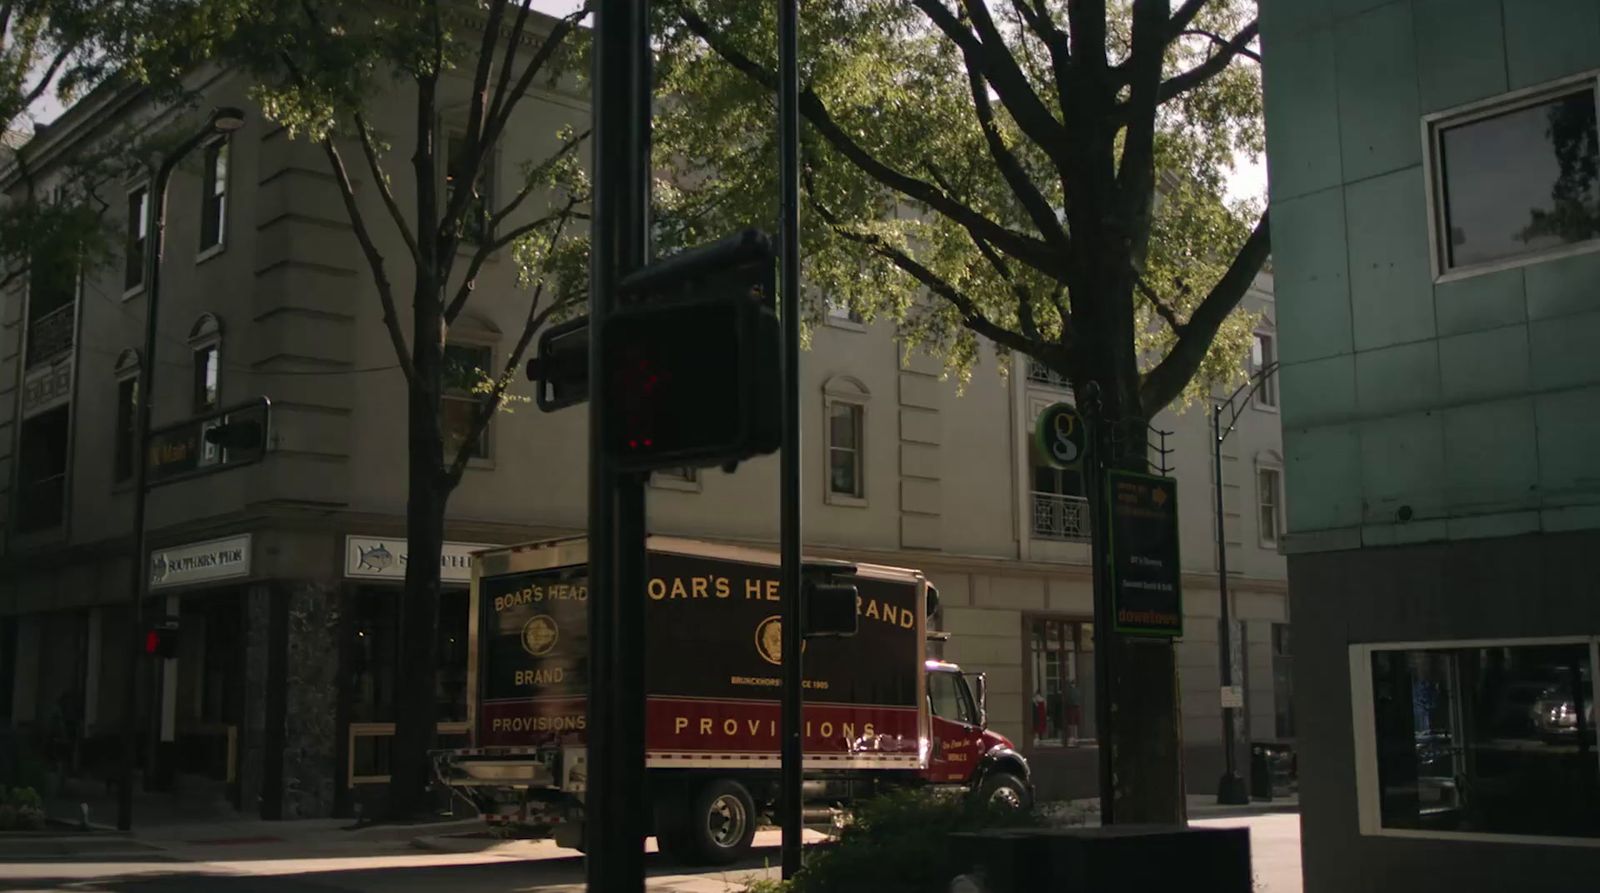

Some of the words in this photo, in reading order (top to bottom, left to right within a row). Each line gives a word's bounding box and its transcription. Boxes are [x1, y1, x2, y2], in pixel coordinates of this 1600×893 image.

[1053, 413, 1078, 461] g
[168, 552, 216, 571] SOUTHERN
[494, 584, 543, 612] BOAR'S
[548, 585, 589, 601] HEAD
[647, 574, 731, 601] OAR'S
[745, 578, 781, 601] HE
[514, 668, 564, 686] BRAND
[492, 715, 587, 732] PROVISIONS
[675, 717, 876, 738] PROVIIONS
